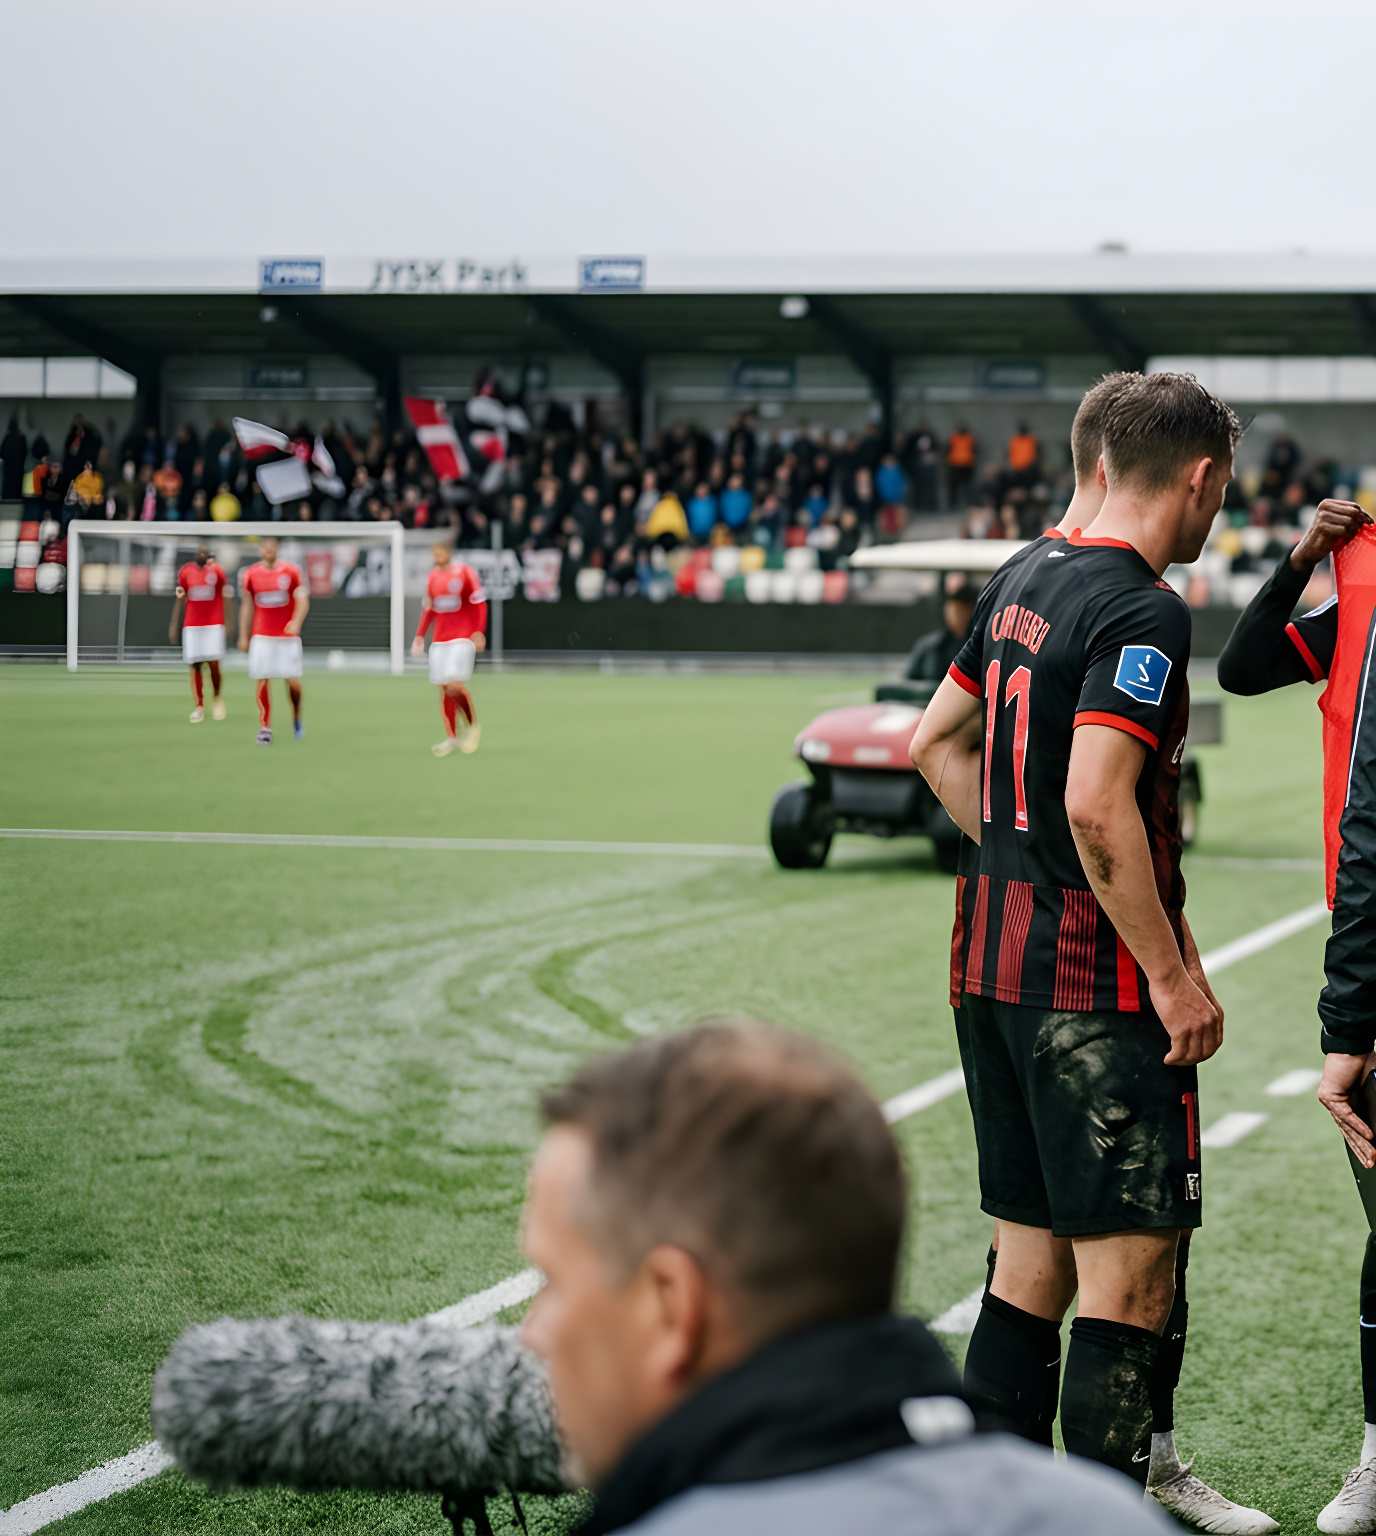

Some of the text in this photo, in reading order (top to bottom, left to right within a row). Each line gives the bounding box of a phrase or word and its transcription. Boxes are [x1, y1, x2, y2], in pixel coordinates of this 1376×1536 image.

[370, 256, 527, 292] JYSK Park
[984, 660, 1031, 831] 11
